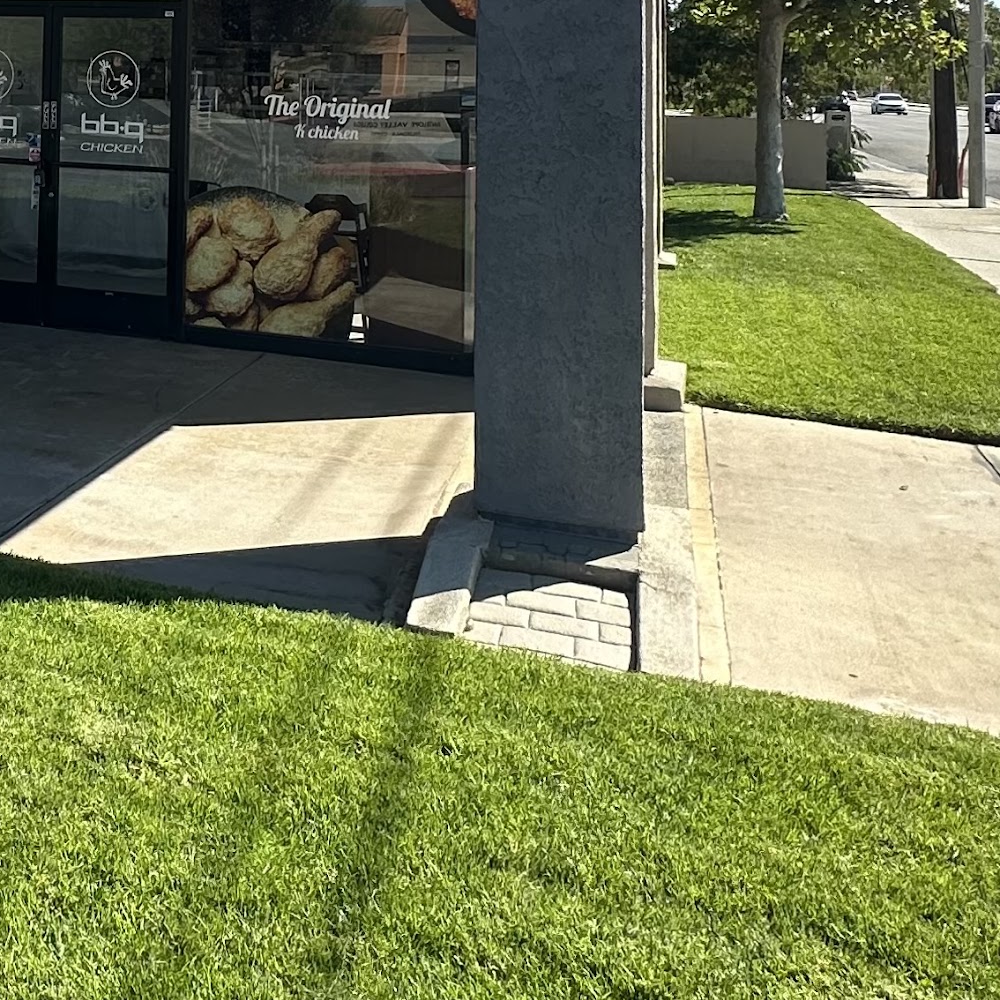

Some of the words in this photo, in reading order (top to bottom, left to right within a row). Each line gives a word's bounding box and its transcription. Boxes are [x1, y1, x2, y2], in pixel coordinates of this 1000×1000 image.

[264, 94, 300, 116] The
[304, 94, 392, 125] Original
[294, 123, 305, 138] K
[307, 124, 359, 140] chicken
[80, 142, 144, 154] CHICKEN
